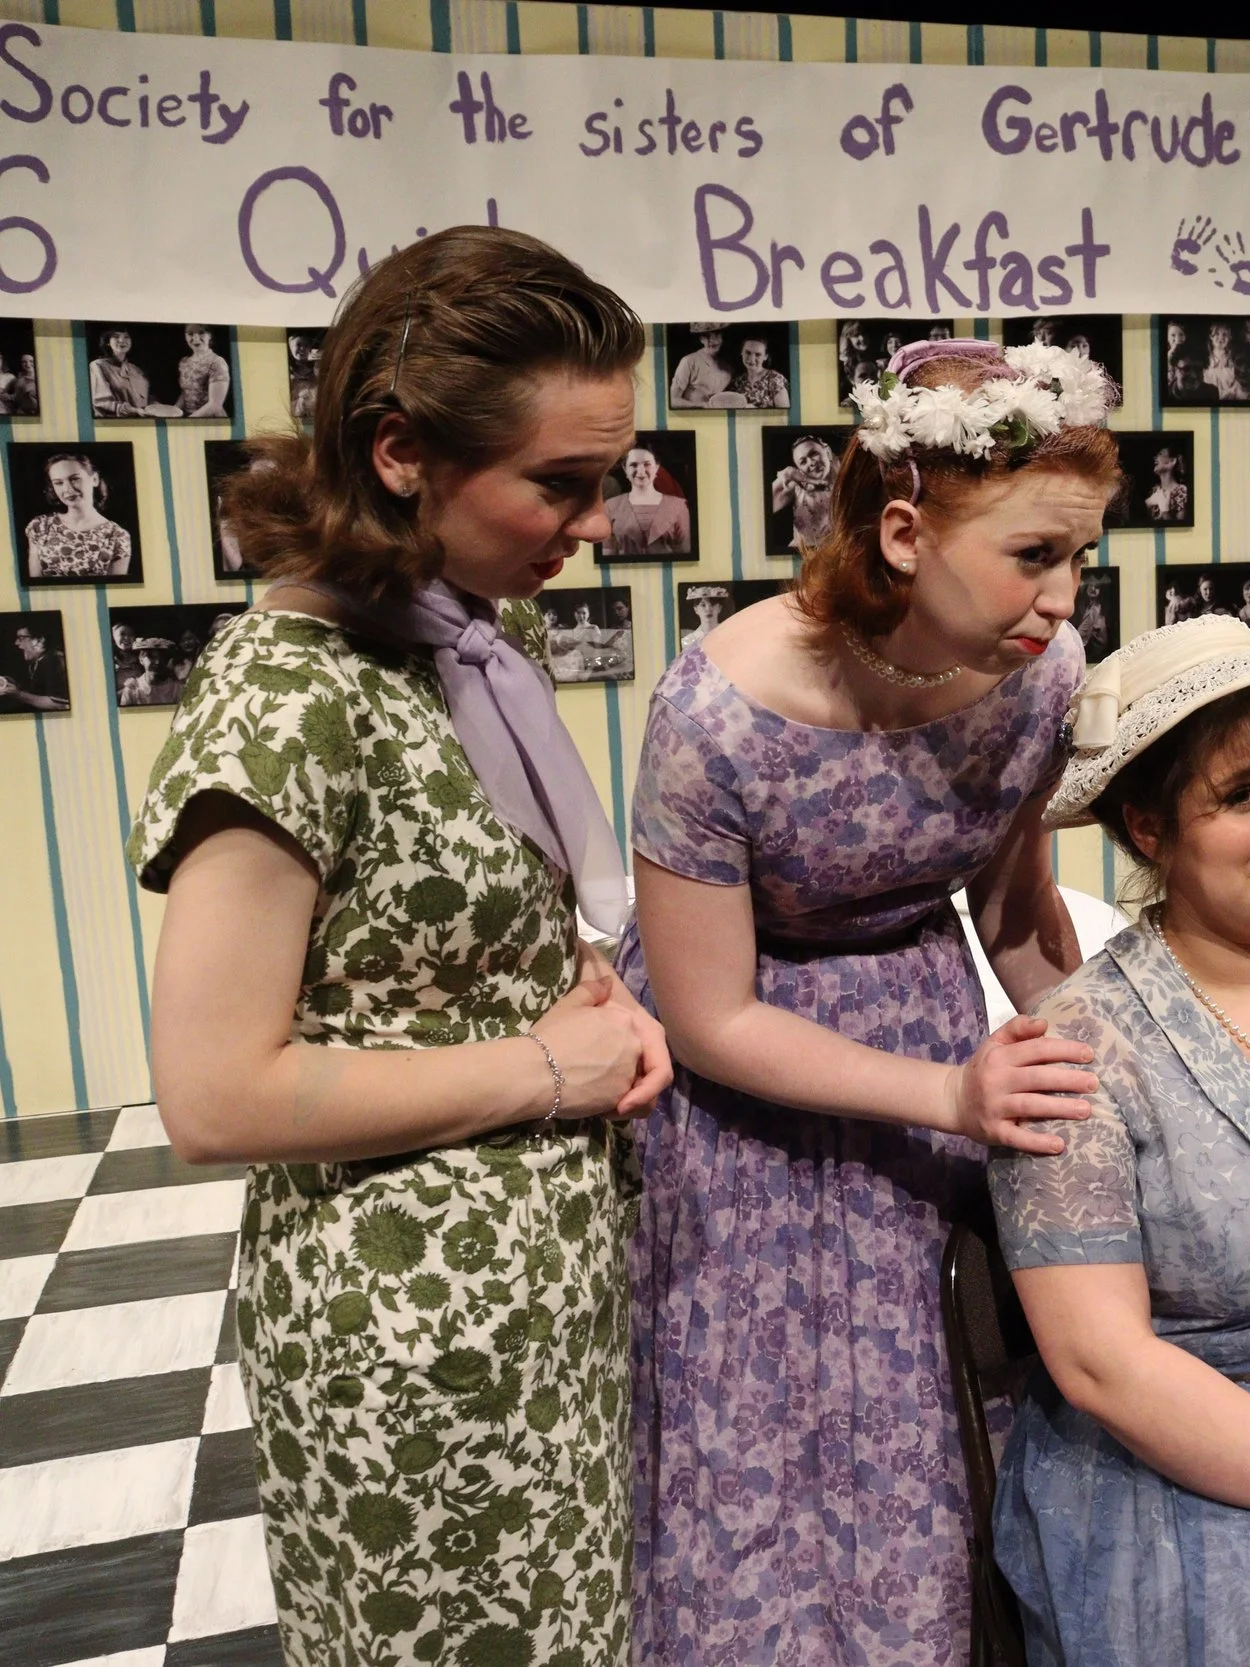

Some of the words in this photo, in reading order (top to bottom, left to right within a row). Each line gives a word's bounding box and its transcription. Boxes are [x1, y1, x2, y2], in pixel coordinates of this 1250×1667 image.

[0, 23, 250, 144] Society
[319, 72, 394, 139] for
[450, 70, 534, 144] the
[578, 88, 764, 158] sisters
[839, 83, 914, 160] of
[981, 85, 1241, 168] Gertrude
[694, 183, 1111, 314] Breakfast
